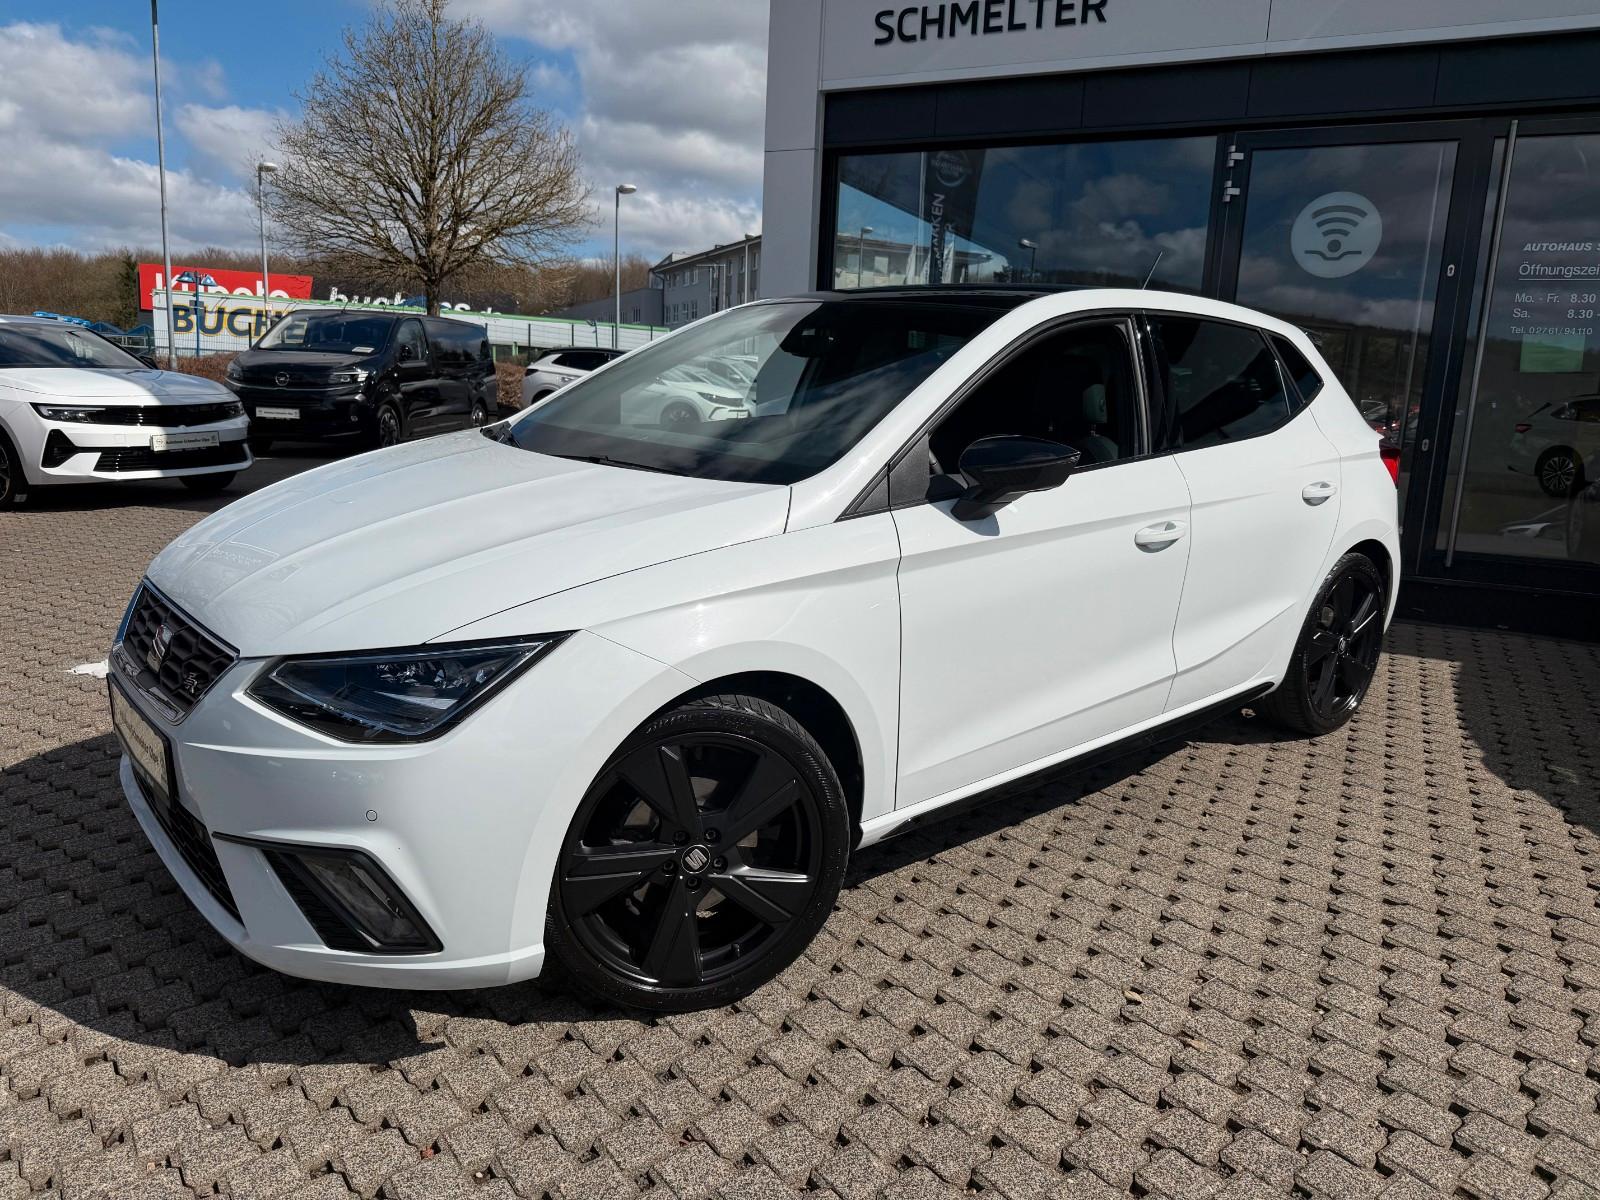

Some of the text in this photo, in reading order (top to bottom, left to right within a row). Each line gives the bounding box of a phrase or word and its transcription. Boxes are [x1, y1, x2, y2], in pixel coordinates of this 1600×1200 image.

[874, 0, 1107, 45] SCHMELTER
[1523, 242, 1593, 252] AUTOHAUS
[1514, 292, 1535, 303] Mo.
[1546, 292, 1560, 303] Fr.
[1570, 293, 1597, 304] 8.30
[1512, 307, 1531, 318] Sa.
[1567, 309, 1594, 319] 8.30
[1510, 325, 1526, 334] Tel.
